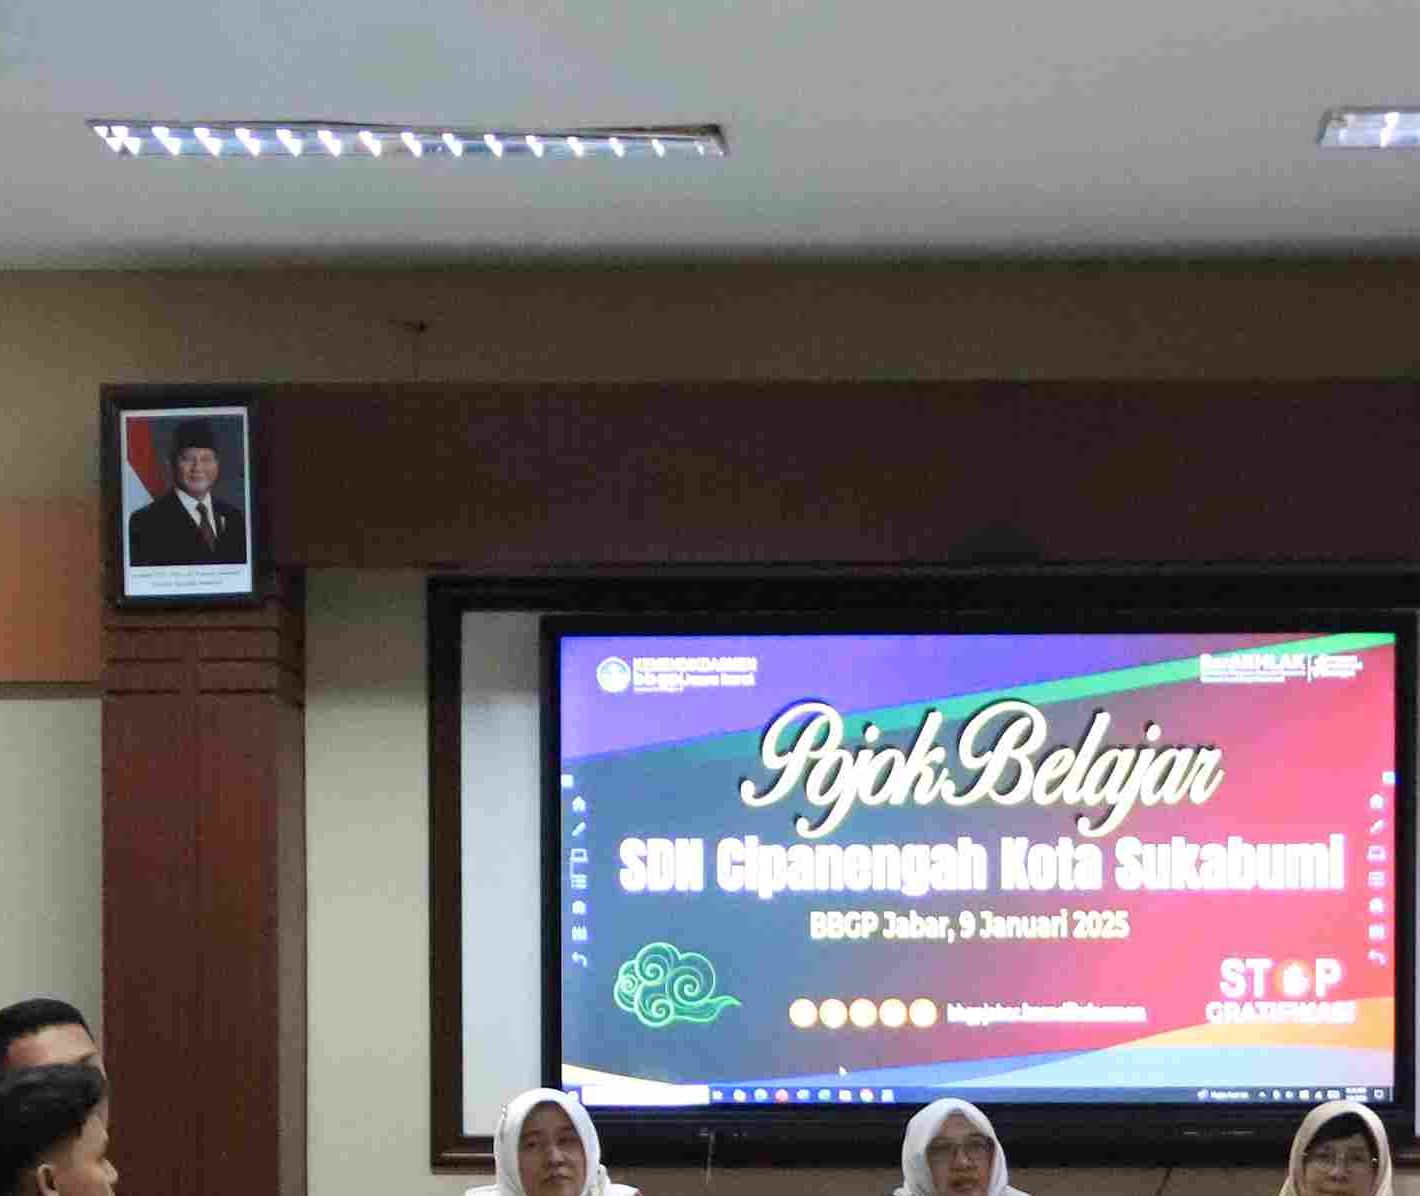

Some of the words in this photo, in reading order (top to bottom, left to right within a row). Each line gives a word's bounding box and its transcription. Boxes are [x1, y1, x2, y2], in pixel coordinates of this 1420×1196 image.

[740, 701, 948, 838] Pojok
[941, 701, 1226, 838] Belajar
[619, 838, 704, 891] SDN
[716, 835, 988, 899] Cipanengah
[1000, 836, 1103, 891] Kota
[1115, 833, 1345, 891] Sukabumi
[810, 911, 879, 939] BBGP
[883, 910, 956, 943] Jabar,
[959, 911, 977, 939] 9
[979, 908, 1068, 939] Januari
[1072, 911, 1130, 939] 2025
